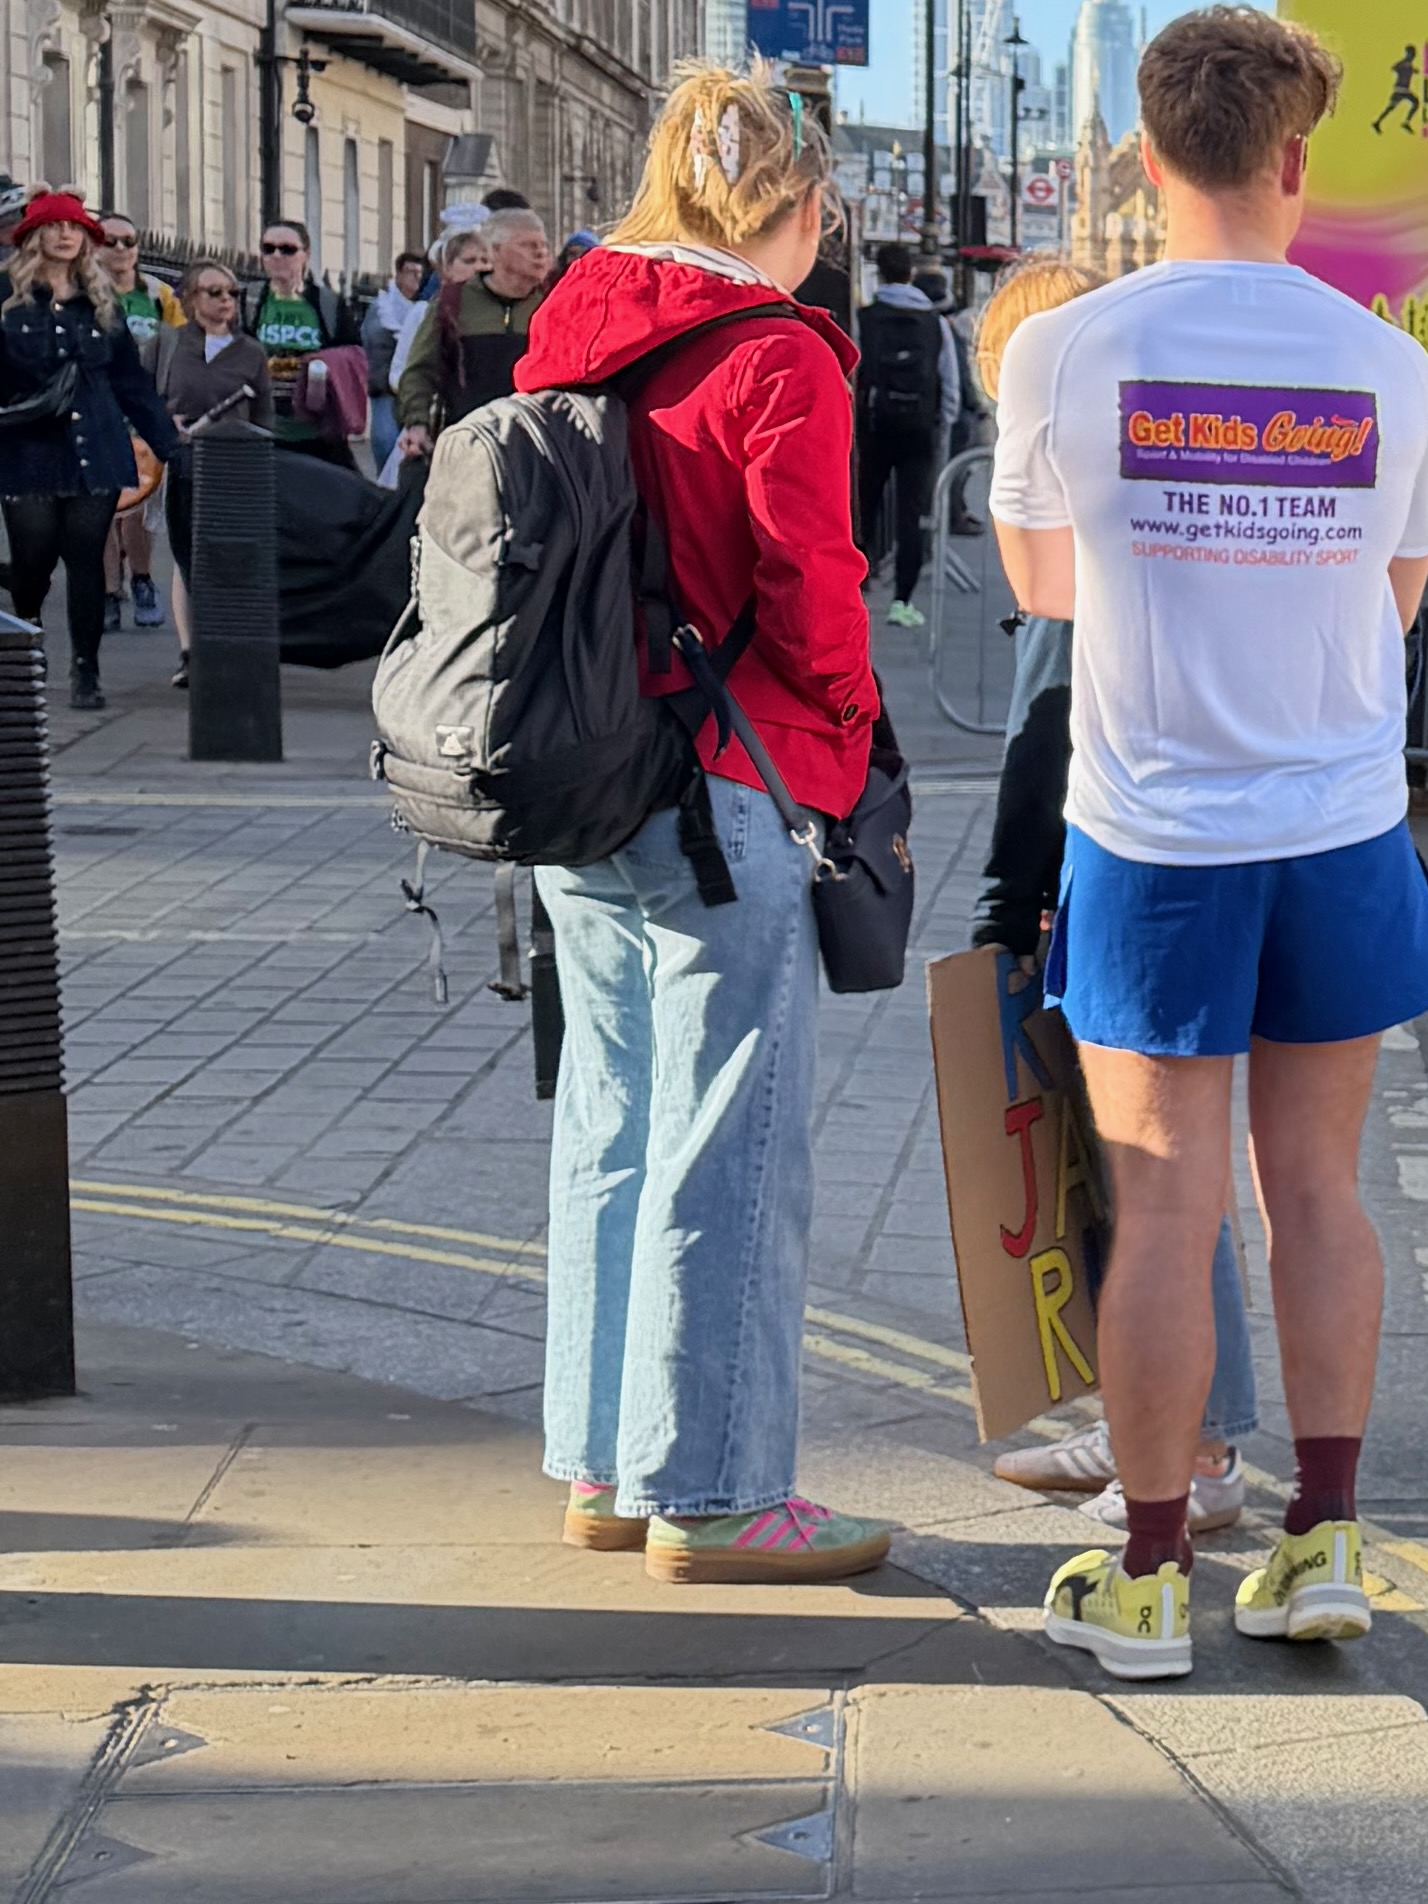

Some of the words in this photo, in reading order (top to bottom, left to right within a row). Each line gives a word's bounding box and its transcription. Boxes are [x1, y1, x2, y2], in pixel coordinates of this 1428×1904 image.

[1128, 410, 1186, 447] Get
[1187, 412, 1258, 451] Kids
[1261, 410, 1373, 463] Going!
[1163, 491, 1210, 515] THE
[1219, 493, 1268, 518] NO.1
[1275, 496, 1337, 518] TEAM
[1130, 517, 1363, 546] www.getkidsgoing.com
[1132, 541, 1231, 565] SUPPORTING
[1233, 547, 1312, 566] DISABILITY
[1316, 549, 1360, 566] SPORT
